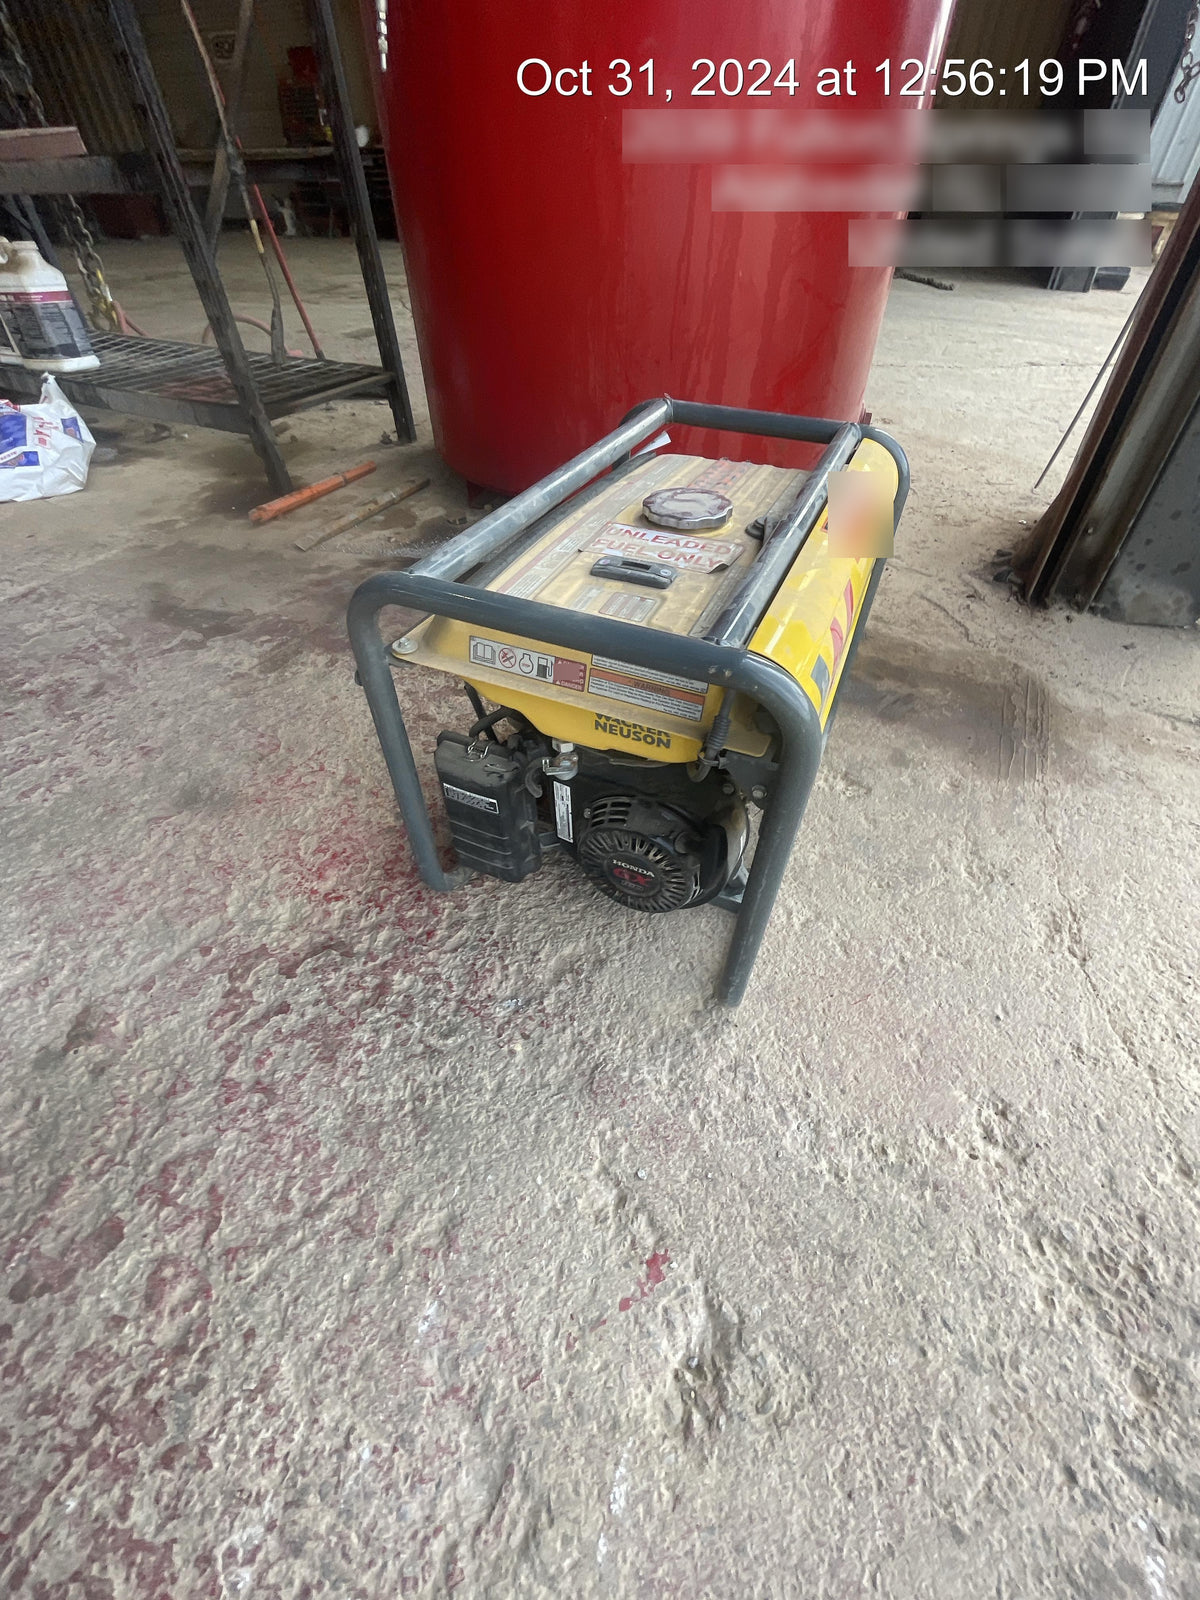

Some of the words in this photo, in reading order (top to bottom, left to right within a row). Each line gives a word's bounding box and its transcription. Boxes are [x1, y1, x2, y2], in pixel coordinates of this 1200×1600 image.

[592, 537, 649, 556] FUEL
[657, 550, 723, 568] ONLY
[607, 526, 731, 555] UNLEADED
[633, 679, 670, 695] WARNING
[594, 719, 671, 748] NEUSON
[612, 859, 655, 878] HONDA
